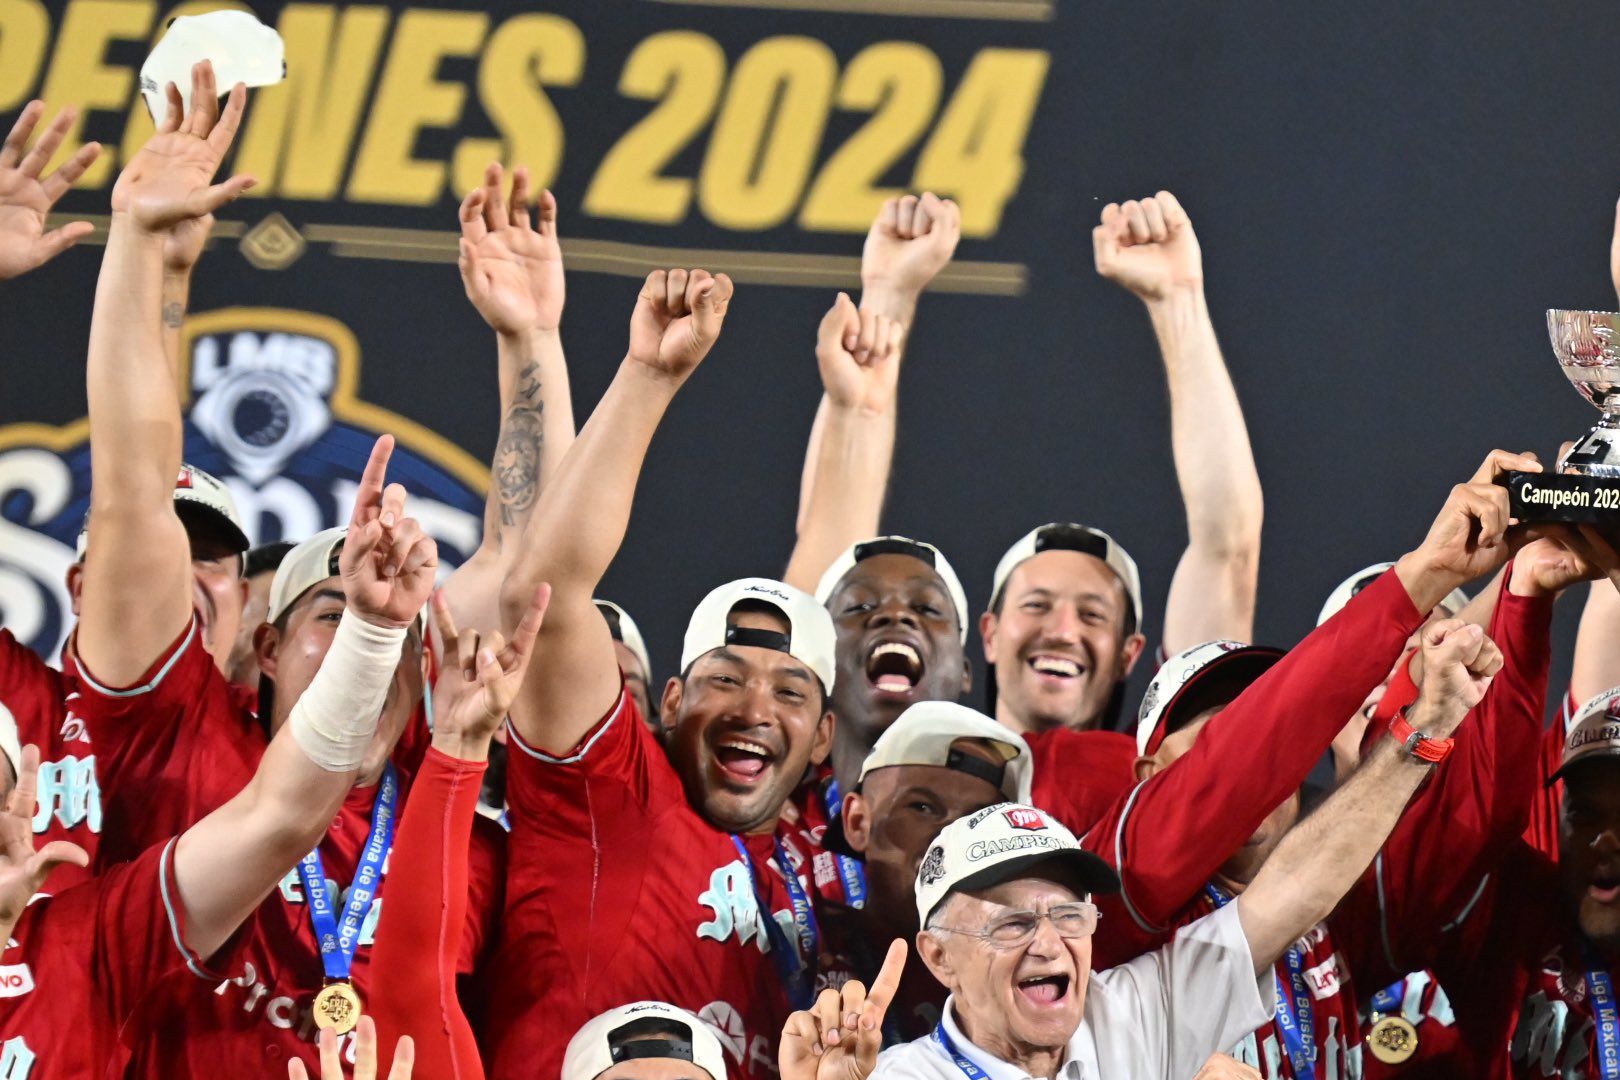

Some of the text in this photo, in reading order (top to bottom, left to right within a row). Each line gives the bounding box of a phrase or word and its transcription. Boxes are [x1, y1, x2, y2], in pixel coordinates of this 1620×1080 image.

[0, 0, 1050, 239] PENES 2024
[1521, 483, 1590, 509] Campeón
[367, 803, 392, 864] Mexicana
[359, 865, 377, 886] de
[340, 889, 371, 955] Beisbol
[1591, 970, 1609, 1003] Liga
[1297, 997, 1313, 1061] Beisbo
